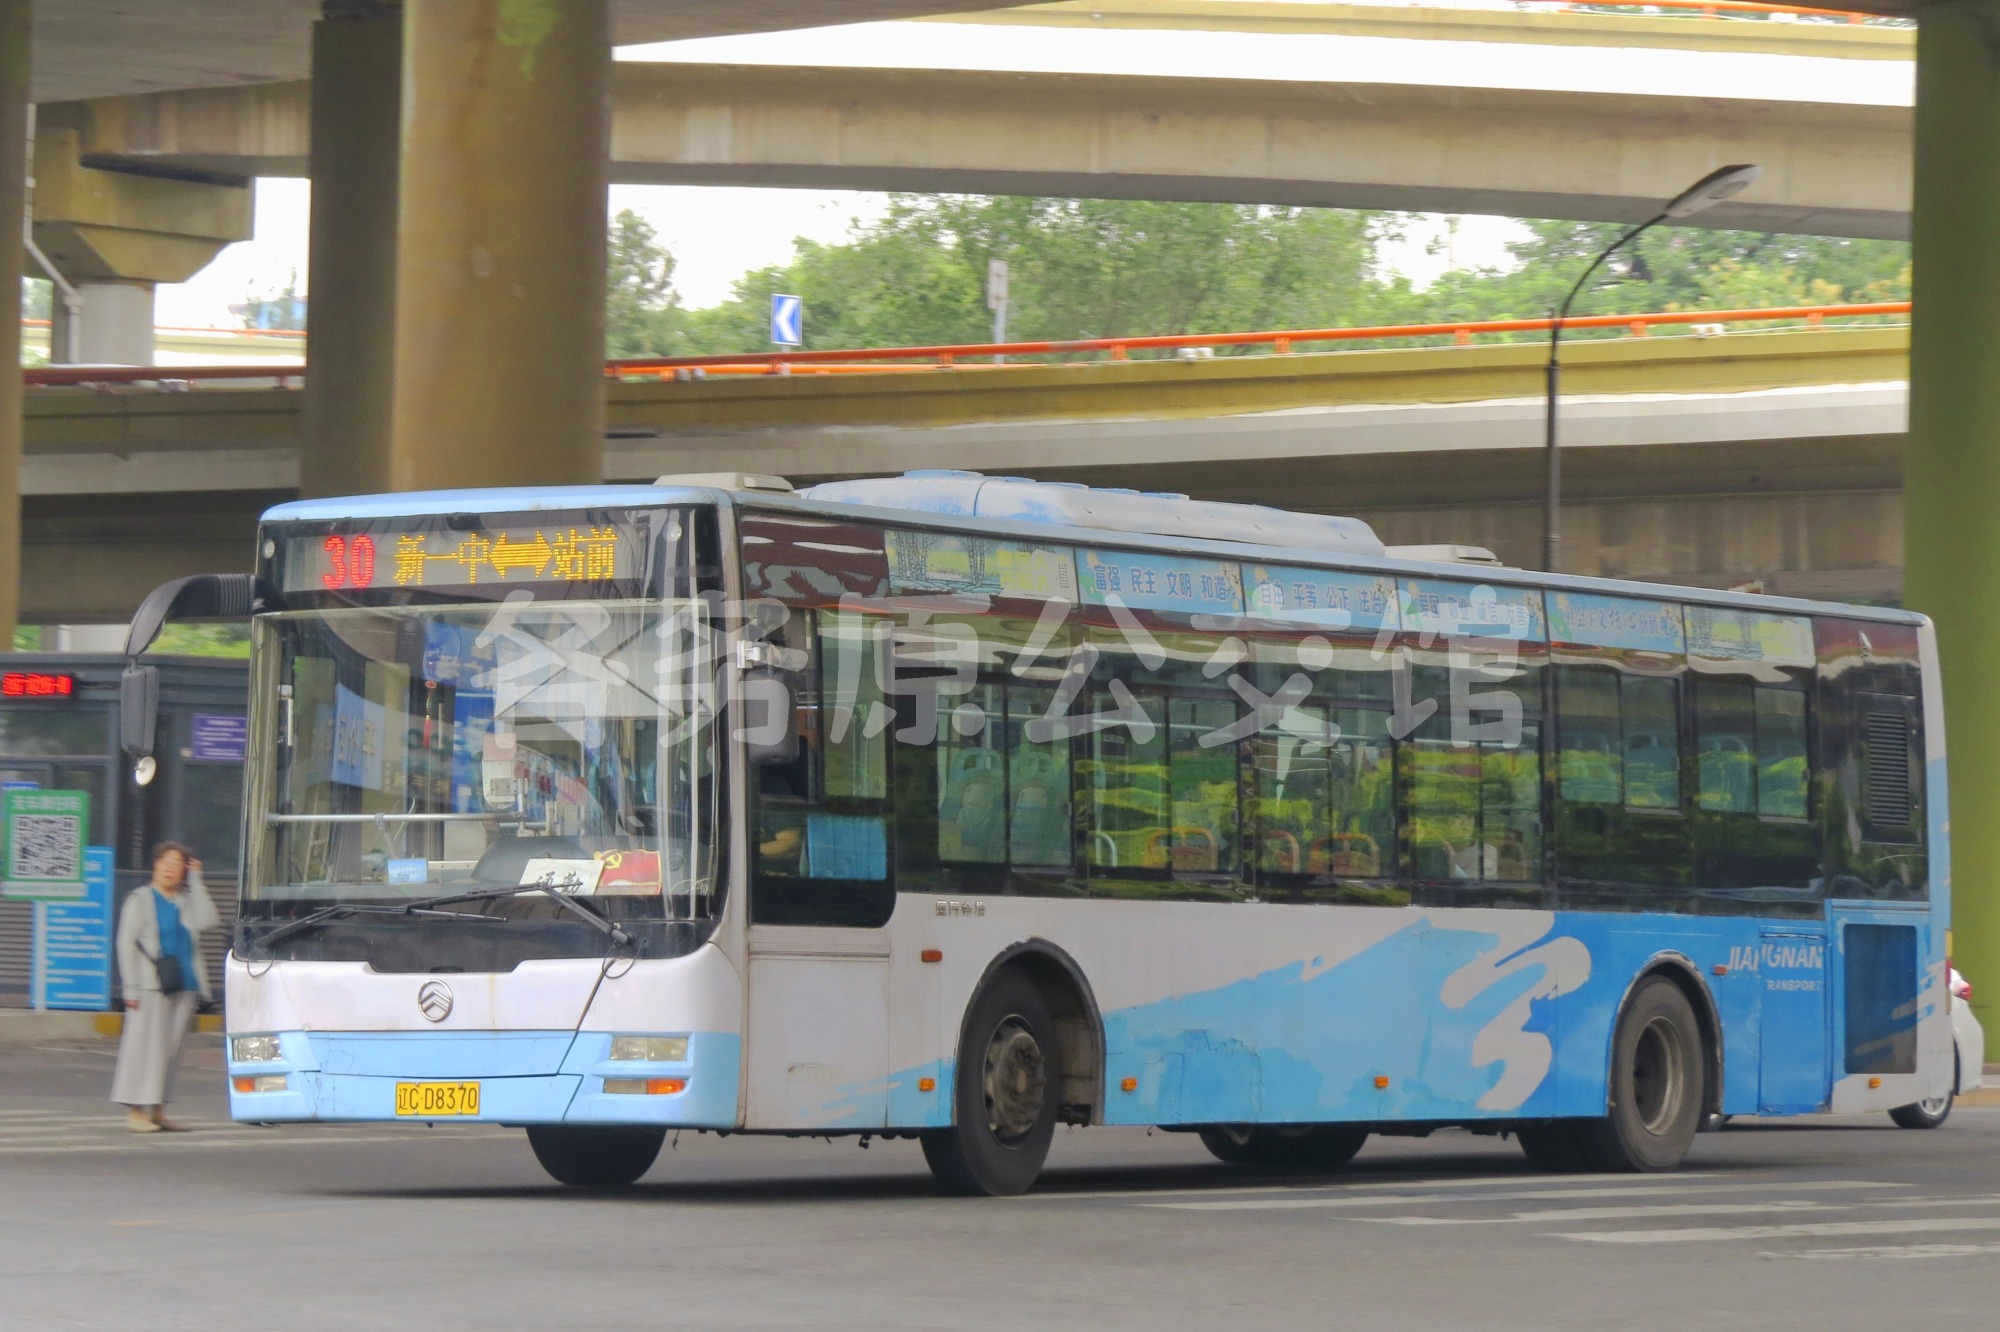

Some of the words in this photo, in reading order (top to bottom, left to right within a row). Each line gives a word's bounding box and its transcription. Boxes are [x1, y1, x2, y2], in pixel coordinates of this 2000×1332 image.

[324, 536, 374, 588] 30
[551, 527, 618, 580] 站前
[1094, 564, 1121, 592] 富强
[1131, 567, 1157, 595] 民主
[1166, 570, 1192, 598] 文明
[1201, 574, 1228, 601] 和谐
[1261, 579, 1284, 605] 自由
[1293, 582, 1317, 609] 平等
[1326, 585, 1349, 609] 公正
[1359, 588, 1386, 615] 法治
[1418, 593, 1440, 619] 爱国
[1764, 979, 1823, 991] RANSPOR
